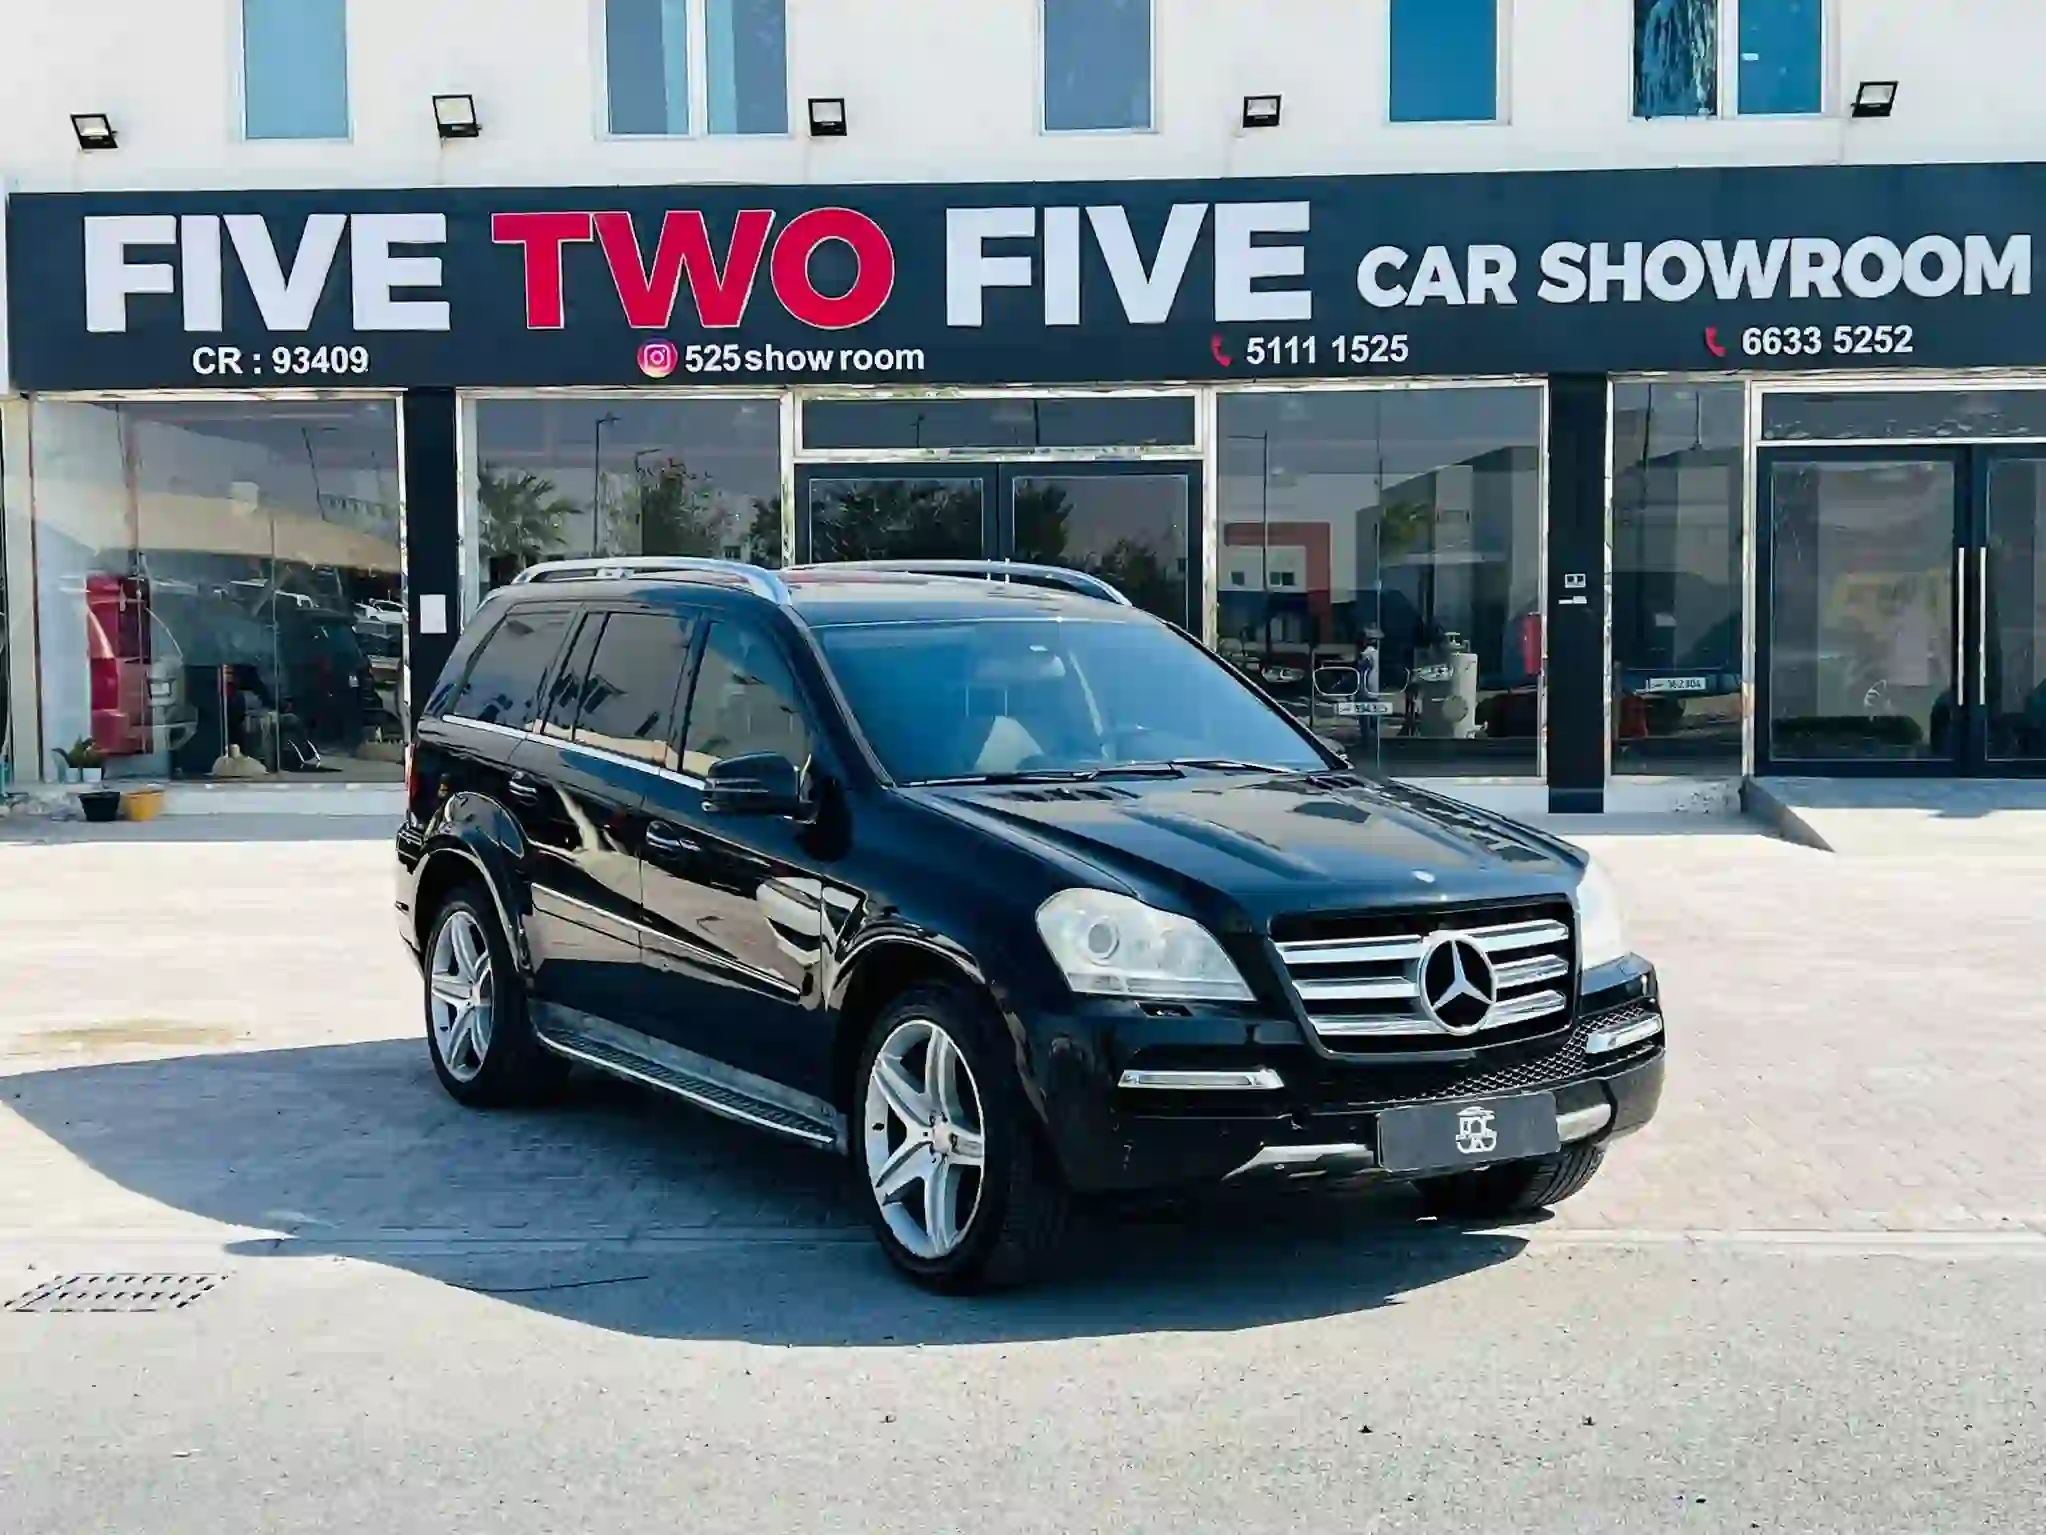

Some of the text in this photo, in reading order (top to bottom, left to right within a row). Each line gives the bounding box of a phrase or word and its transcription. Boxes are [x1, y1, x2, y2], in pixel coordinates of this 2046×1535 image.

[83, 200, 2032, 333] FIVE TWO FIVE CAR SHOWROOM
[1246, 334, 1410, 365] 5111 1525
[1742, 324, 1914, 356] 6633 5252
[192, 346, 244, 375] CR
[271, 346, 370, 375] 93409
